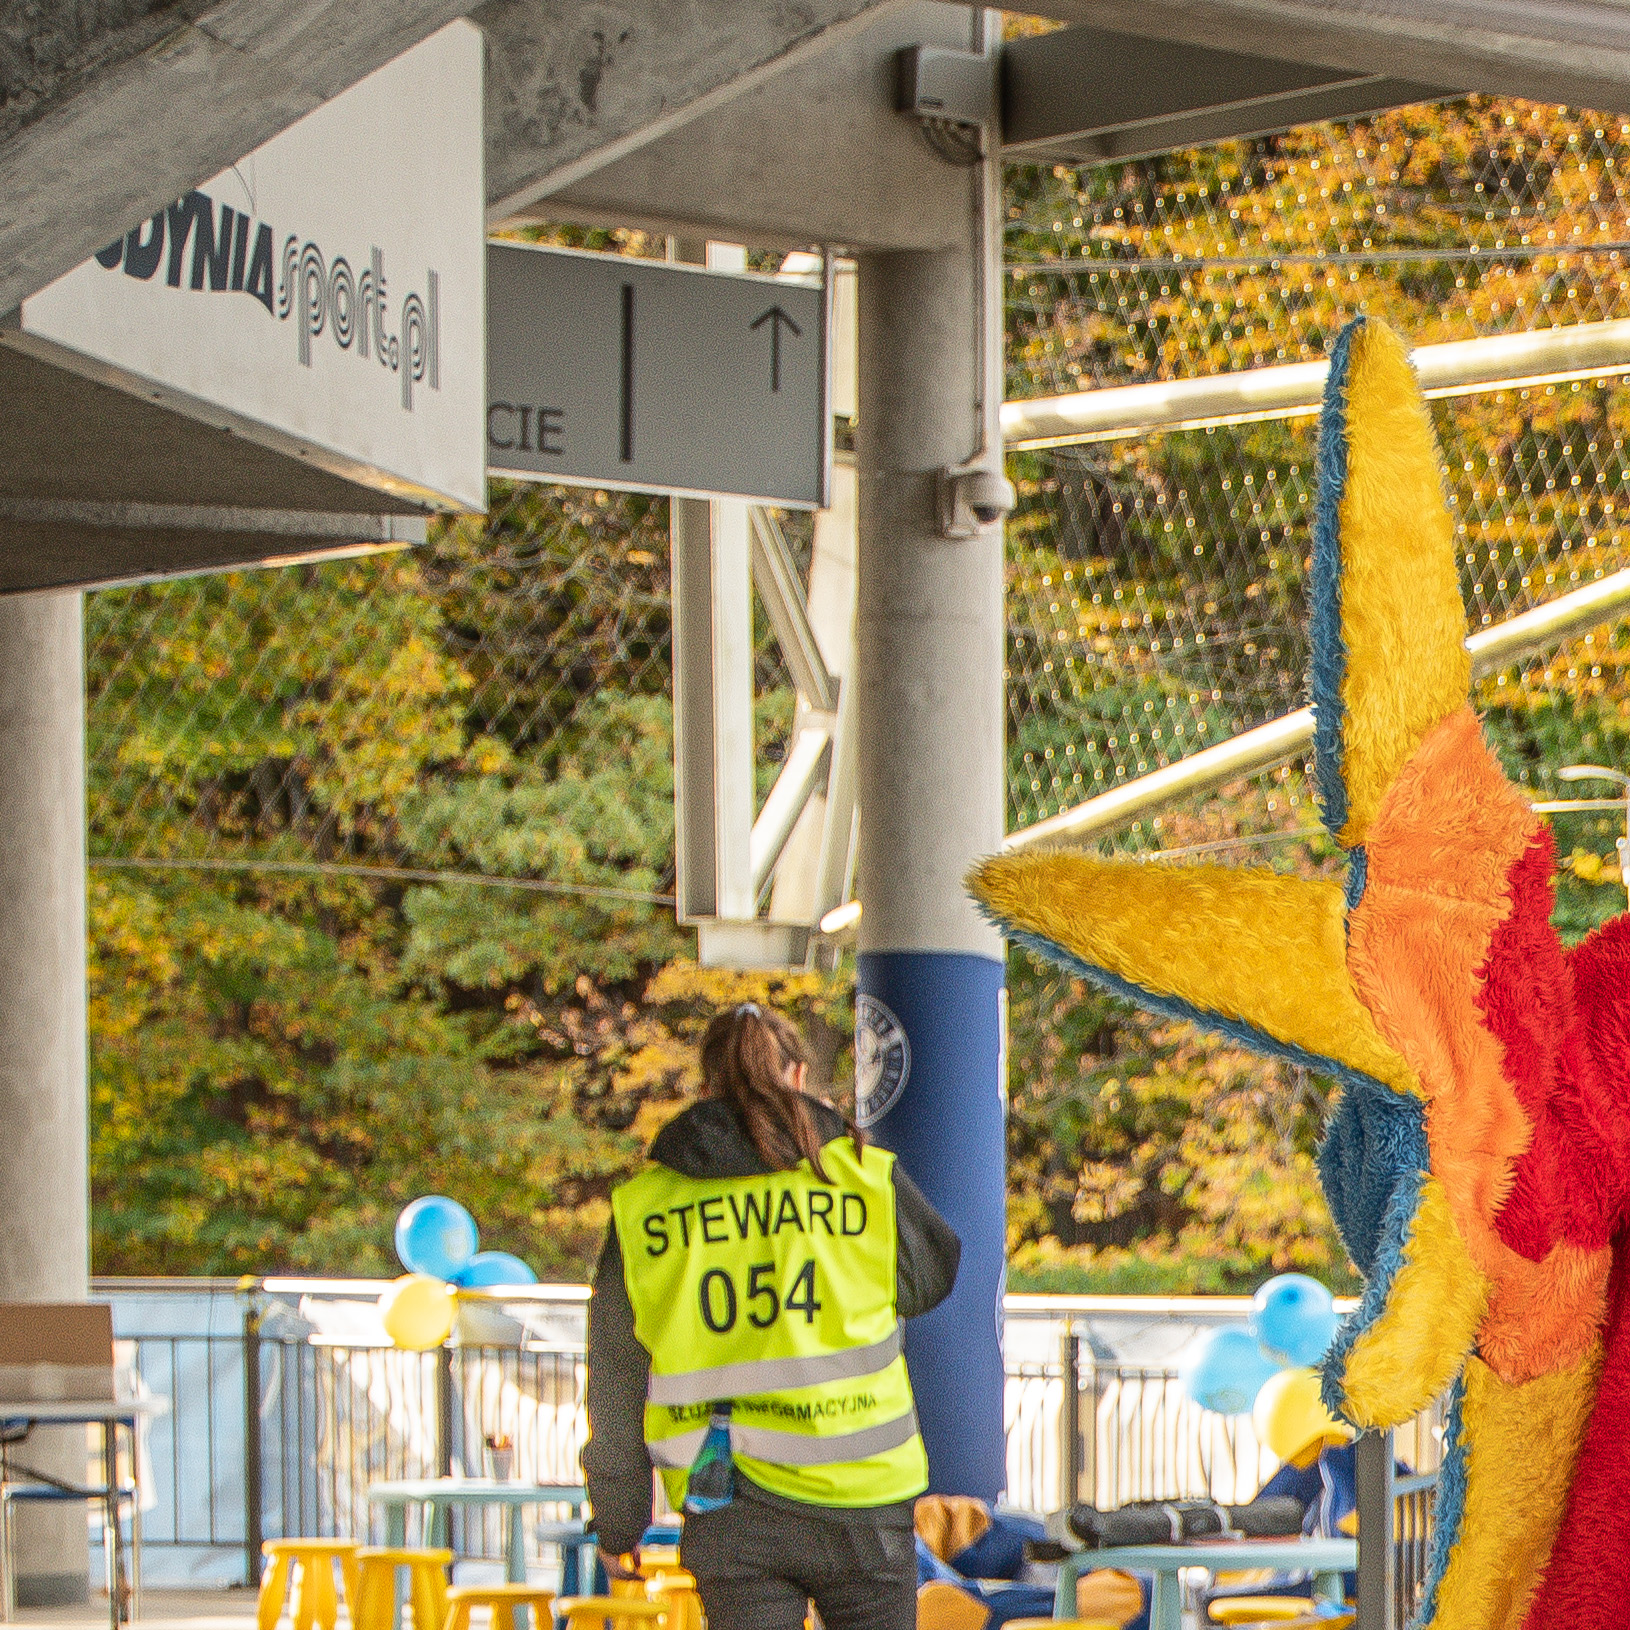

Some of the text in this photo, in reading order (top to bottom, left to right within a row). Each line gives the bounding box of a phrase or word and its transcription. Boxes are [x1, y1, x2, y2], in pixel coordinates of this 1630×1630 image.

[487, 401, 564, 455] CIE
[643, 1188, 869, 1257] STEWARD
[699, 1258, 822, 1334] 054
